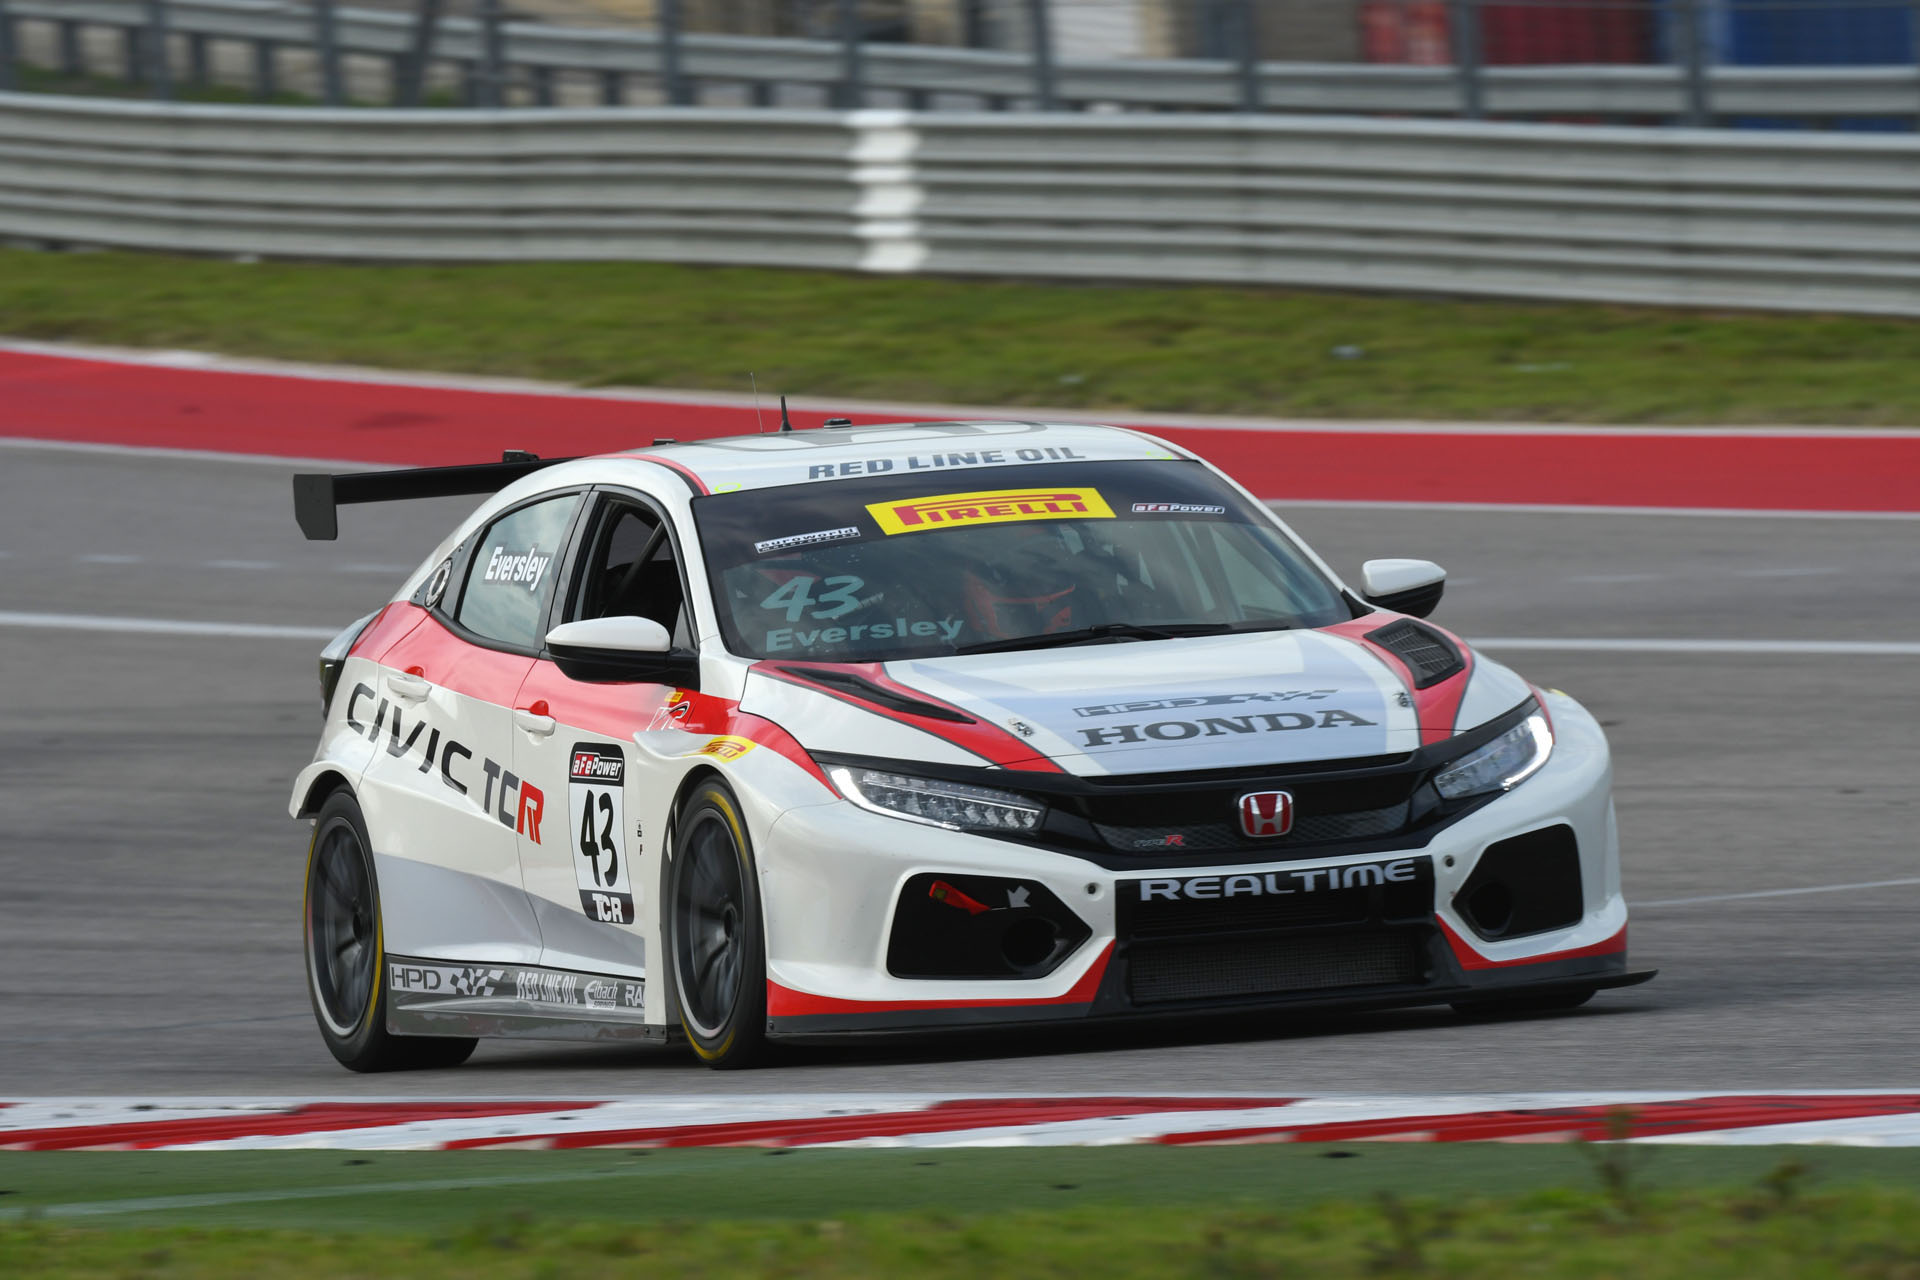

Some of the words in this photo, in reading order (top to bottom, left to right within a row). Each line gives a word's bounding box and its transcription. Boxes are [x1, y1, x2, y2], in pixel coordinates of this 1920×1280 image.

[809, 459, 893, 479] RED
[907, 451, 1005, 469] LINE
[1015, 447, 1086, 461] OIL
[892, 494, 1089, 526] PIRELLI
[1135, 503, 1223, 514] aFePower
[485, 546, 549, 591] Eversley
[760, 575, 864, 622] 43
[766, 618, 964, 652] Eversley
[1078, 709, 1377, 747] HONDA
[347, 682, 473, 795] CIVIC
[483, 757, 545, 845] TCR
[572, 755, 622, 777] aFePower
[580, 788, 618, 887] 43
[1140, 858, 1416, 901] REALTIME
[592, 893, 624, 923] TCR
[391, 966, 442, 990] HPD
[516, 971, 540, 1000] RED
[539, 973, 562, 1003] LINE
[561, 976, 578, 1005] OIL
[584, 980, 618, 1002] Eibach
[625, 984, 645, 1008] RA
